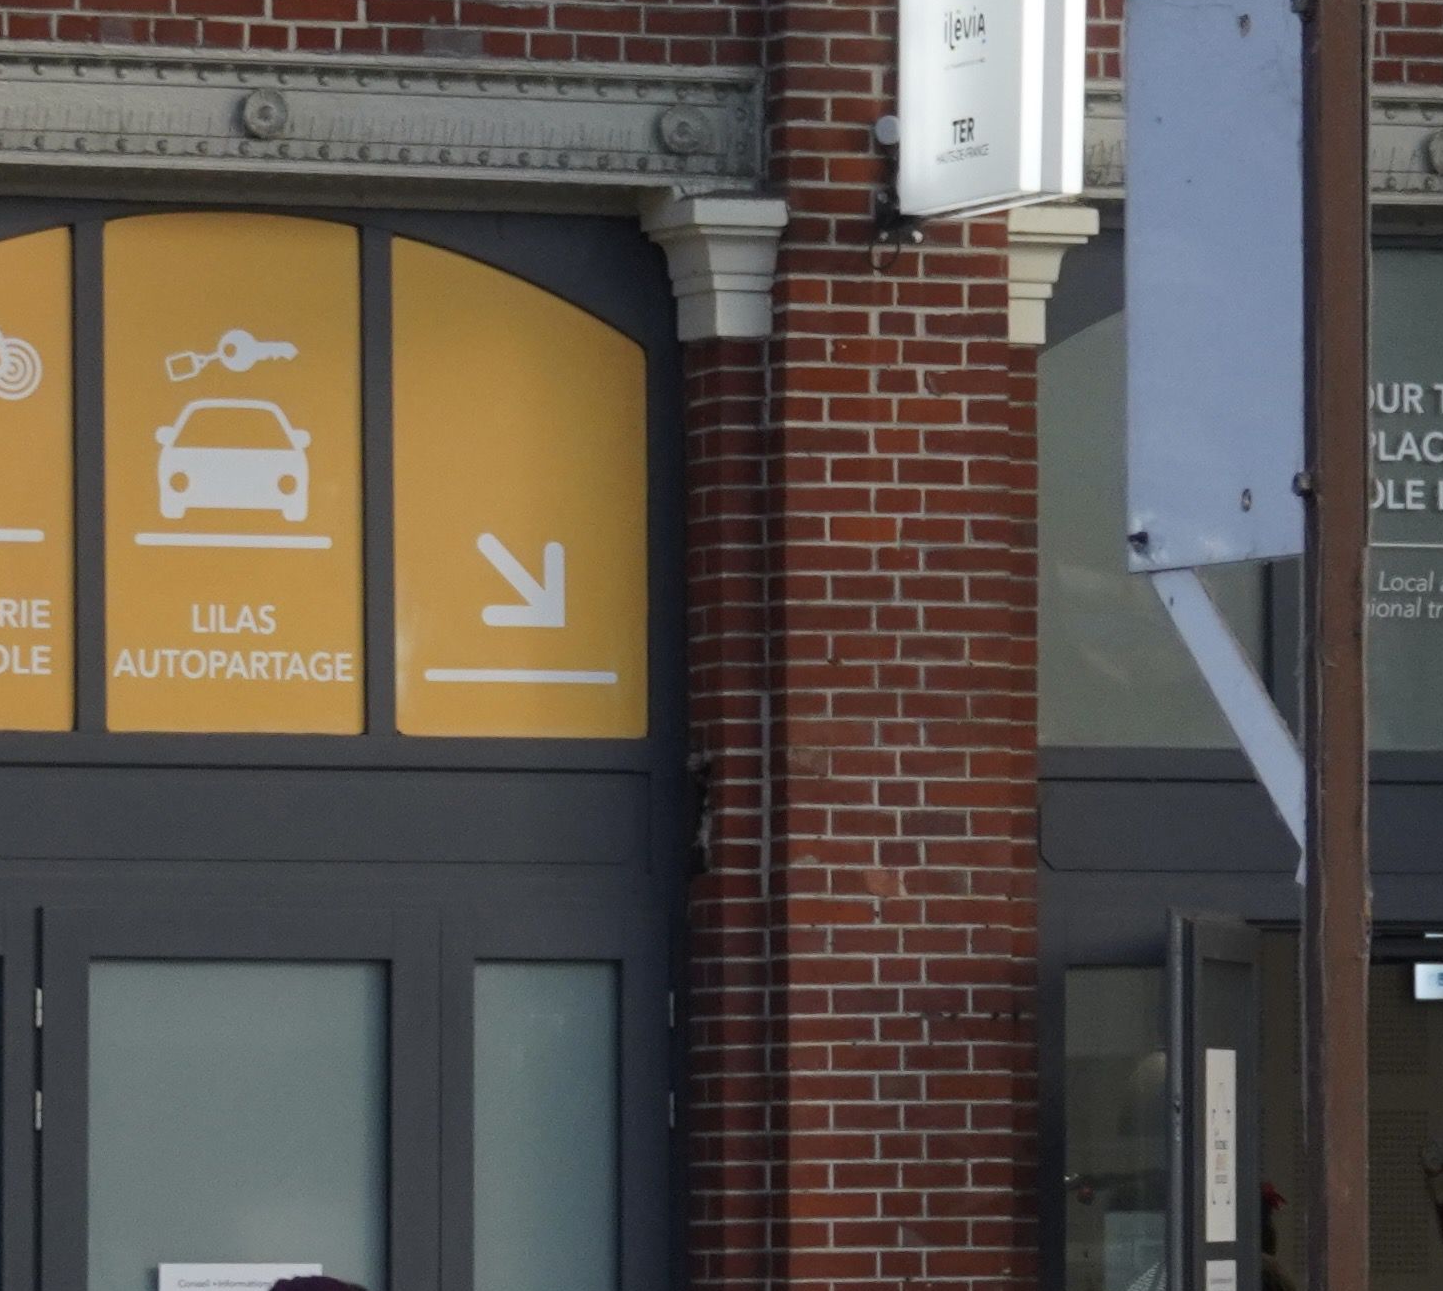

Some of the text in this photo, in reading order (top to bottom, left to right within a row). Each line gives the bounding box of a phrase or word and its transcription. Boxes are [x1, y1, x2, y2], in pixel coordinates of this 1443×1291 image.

[952, 117, 975, 144] TER
[1378, 570, 1435, 592] Local
[190, 603, 276, 636] LILAS
[113, 649, 355, 685] AUTOPARTAGE
